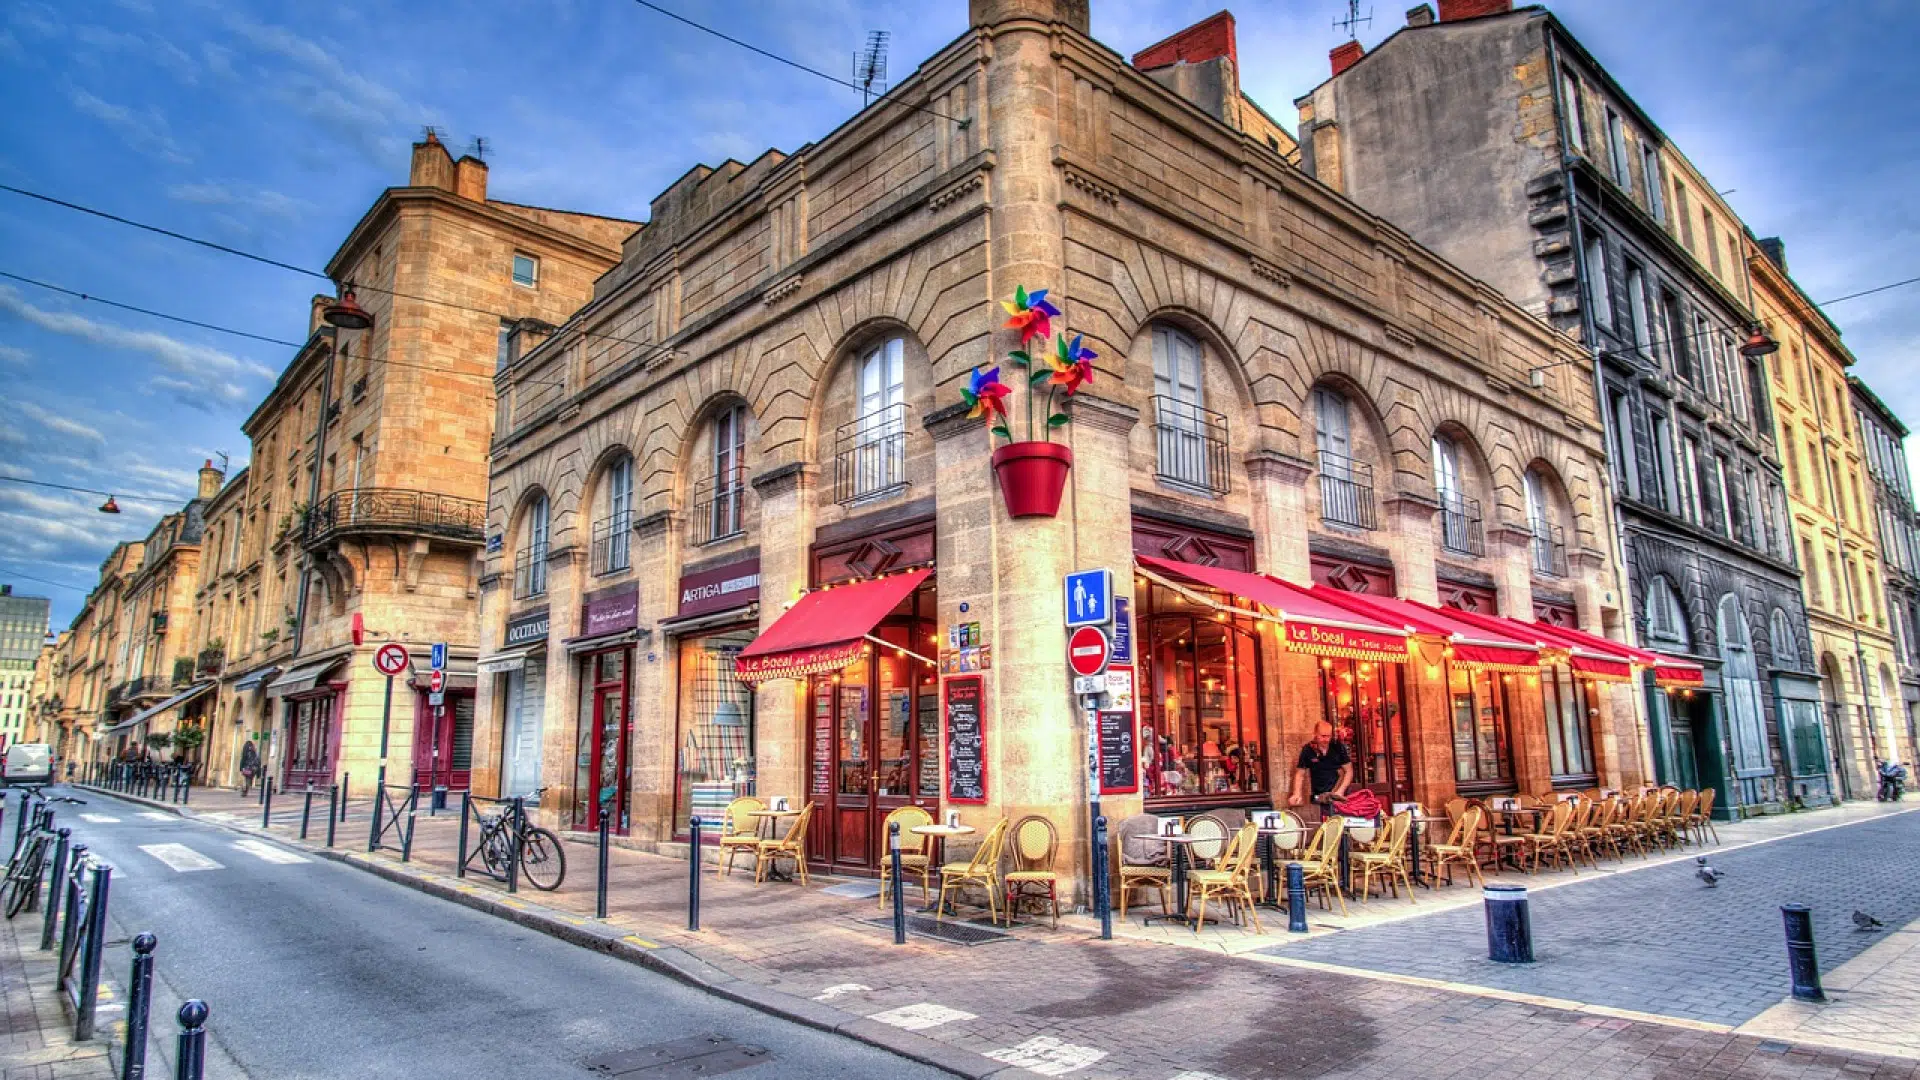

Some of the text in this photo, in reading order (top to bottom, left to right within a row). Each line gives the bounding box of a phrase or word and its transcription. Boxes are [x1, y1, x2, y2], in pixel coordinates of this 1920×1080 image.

[682, 583, 720, 603] ARTIGA
[1291, 625, 1308, 640] Le
[1311, 626, 1344, 646] Bocal
[746, 657, 758, 671] Le
[762, 655, 793, 670] Bocal
